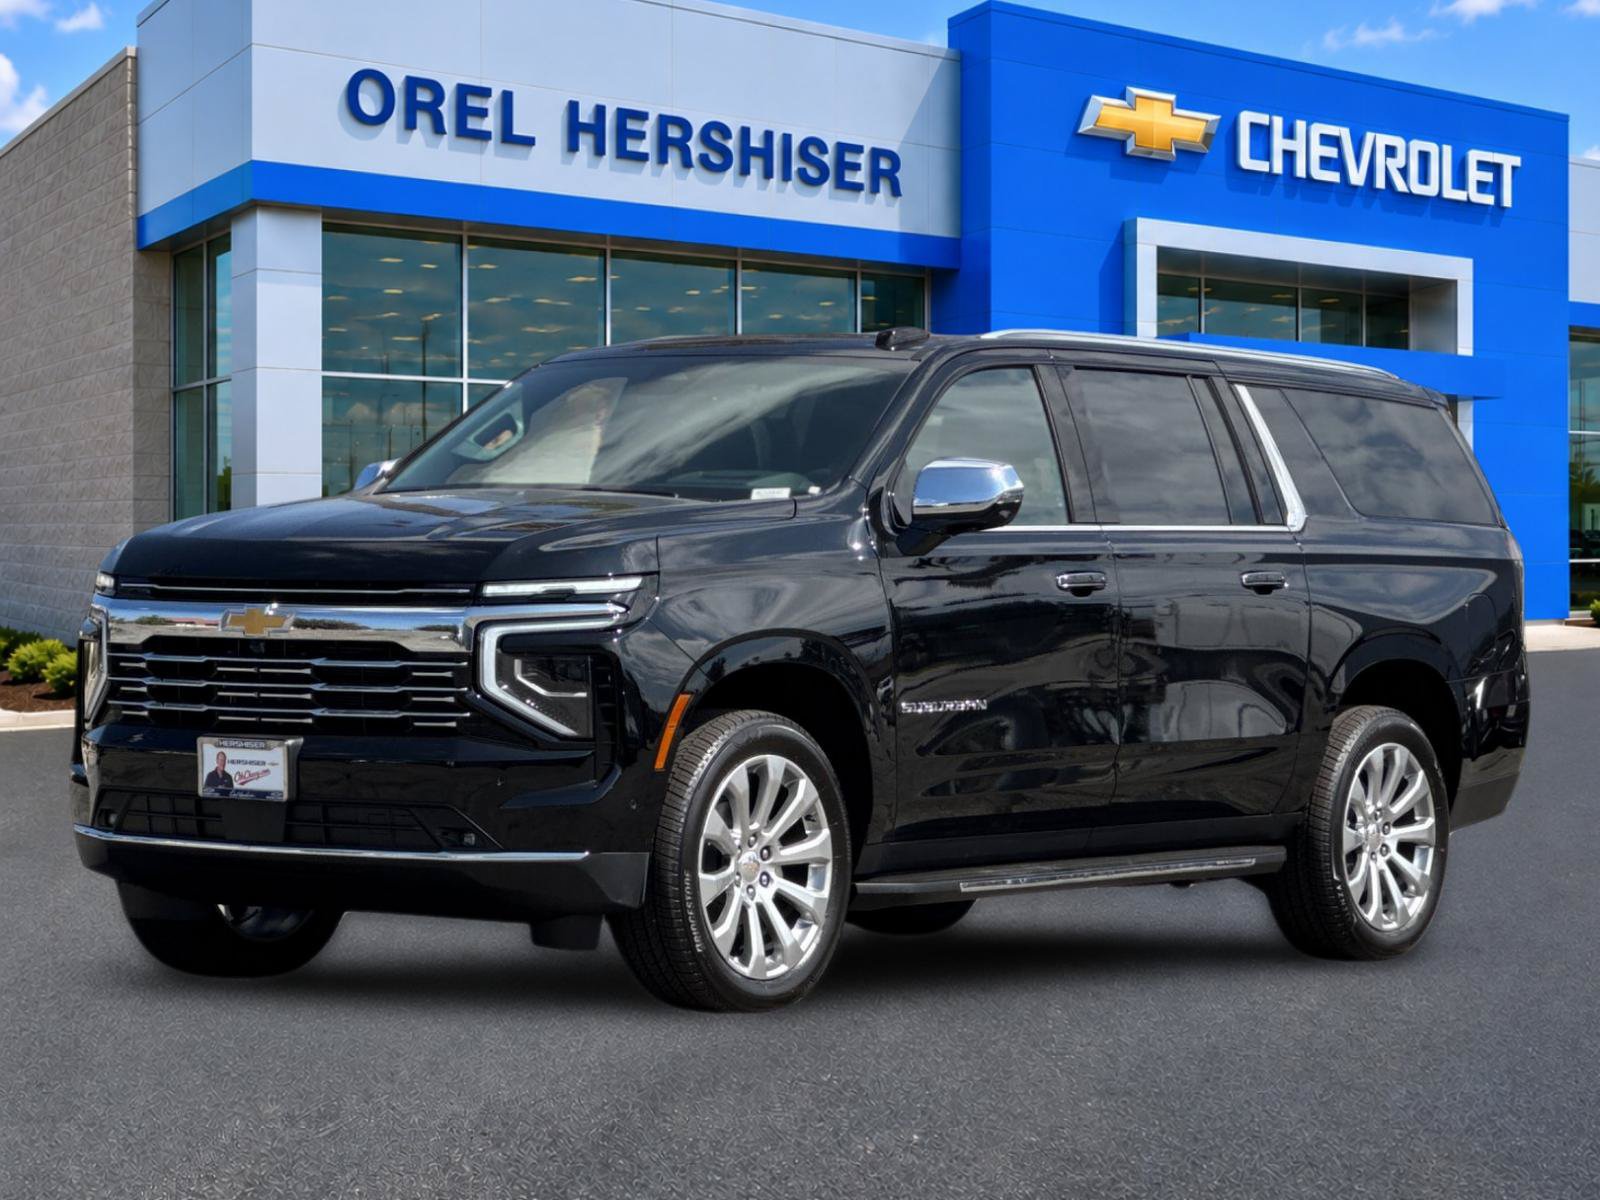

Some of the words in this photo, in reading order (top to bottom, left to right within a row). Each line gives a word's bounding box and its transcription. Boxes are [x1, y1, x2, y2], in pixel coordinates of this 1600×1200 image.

[346, 68, 536, 147] OREL
[567, 99, 902, 197] HERSHISER
[1237, 109, 1522, 208] CHEVROLET
[900, 699, 988, 714] SUBURBAN
[219, 739, 265, 748] HERSHISER
[227, 758, 266, 767] HERSHISER
